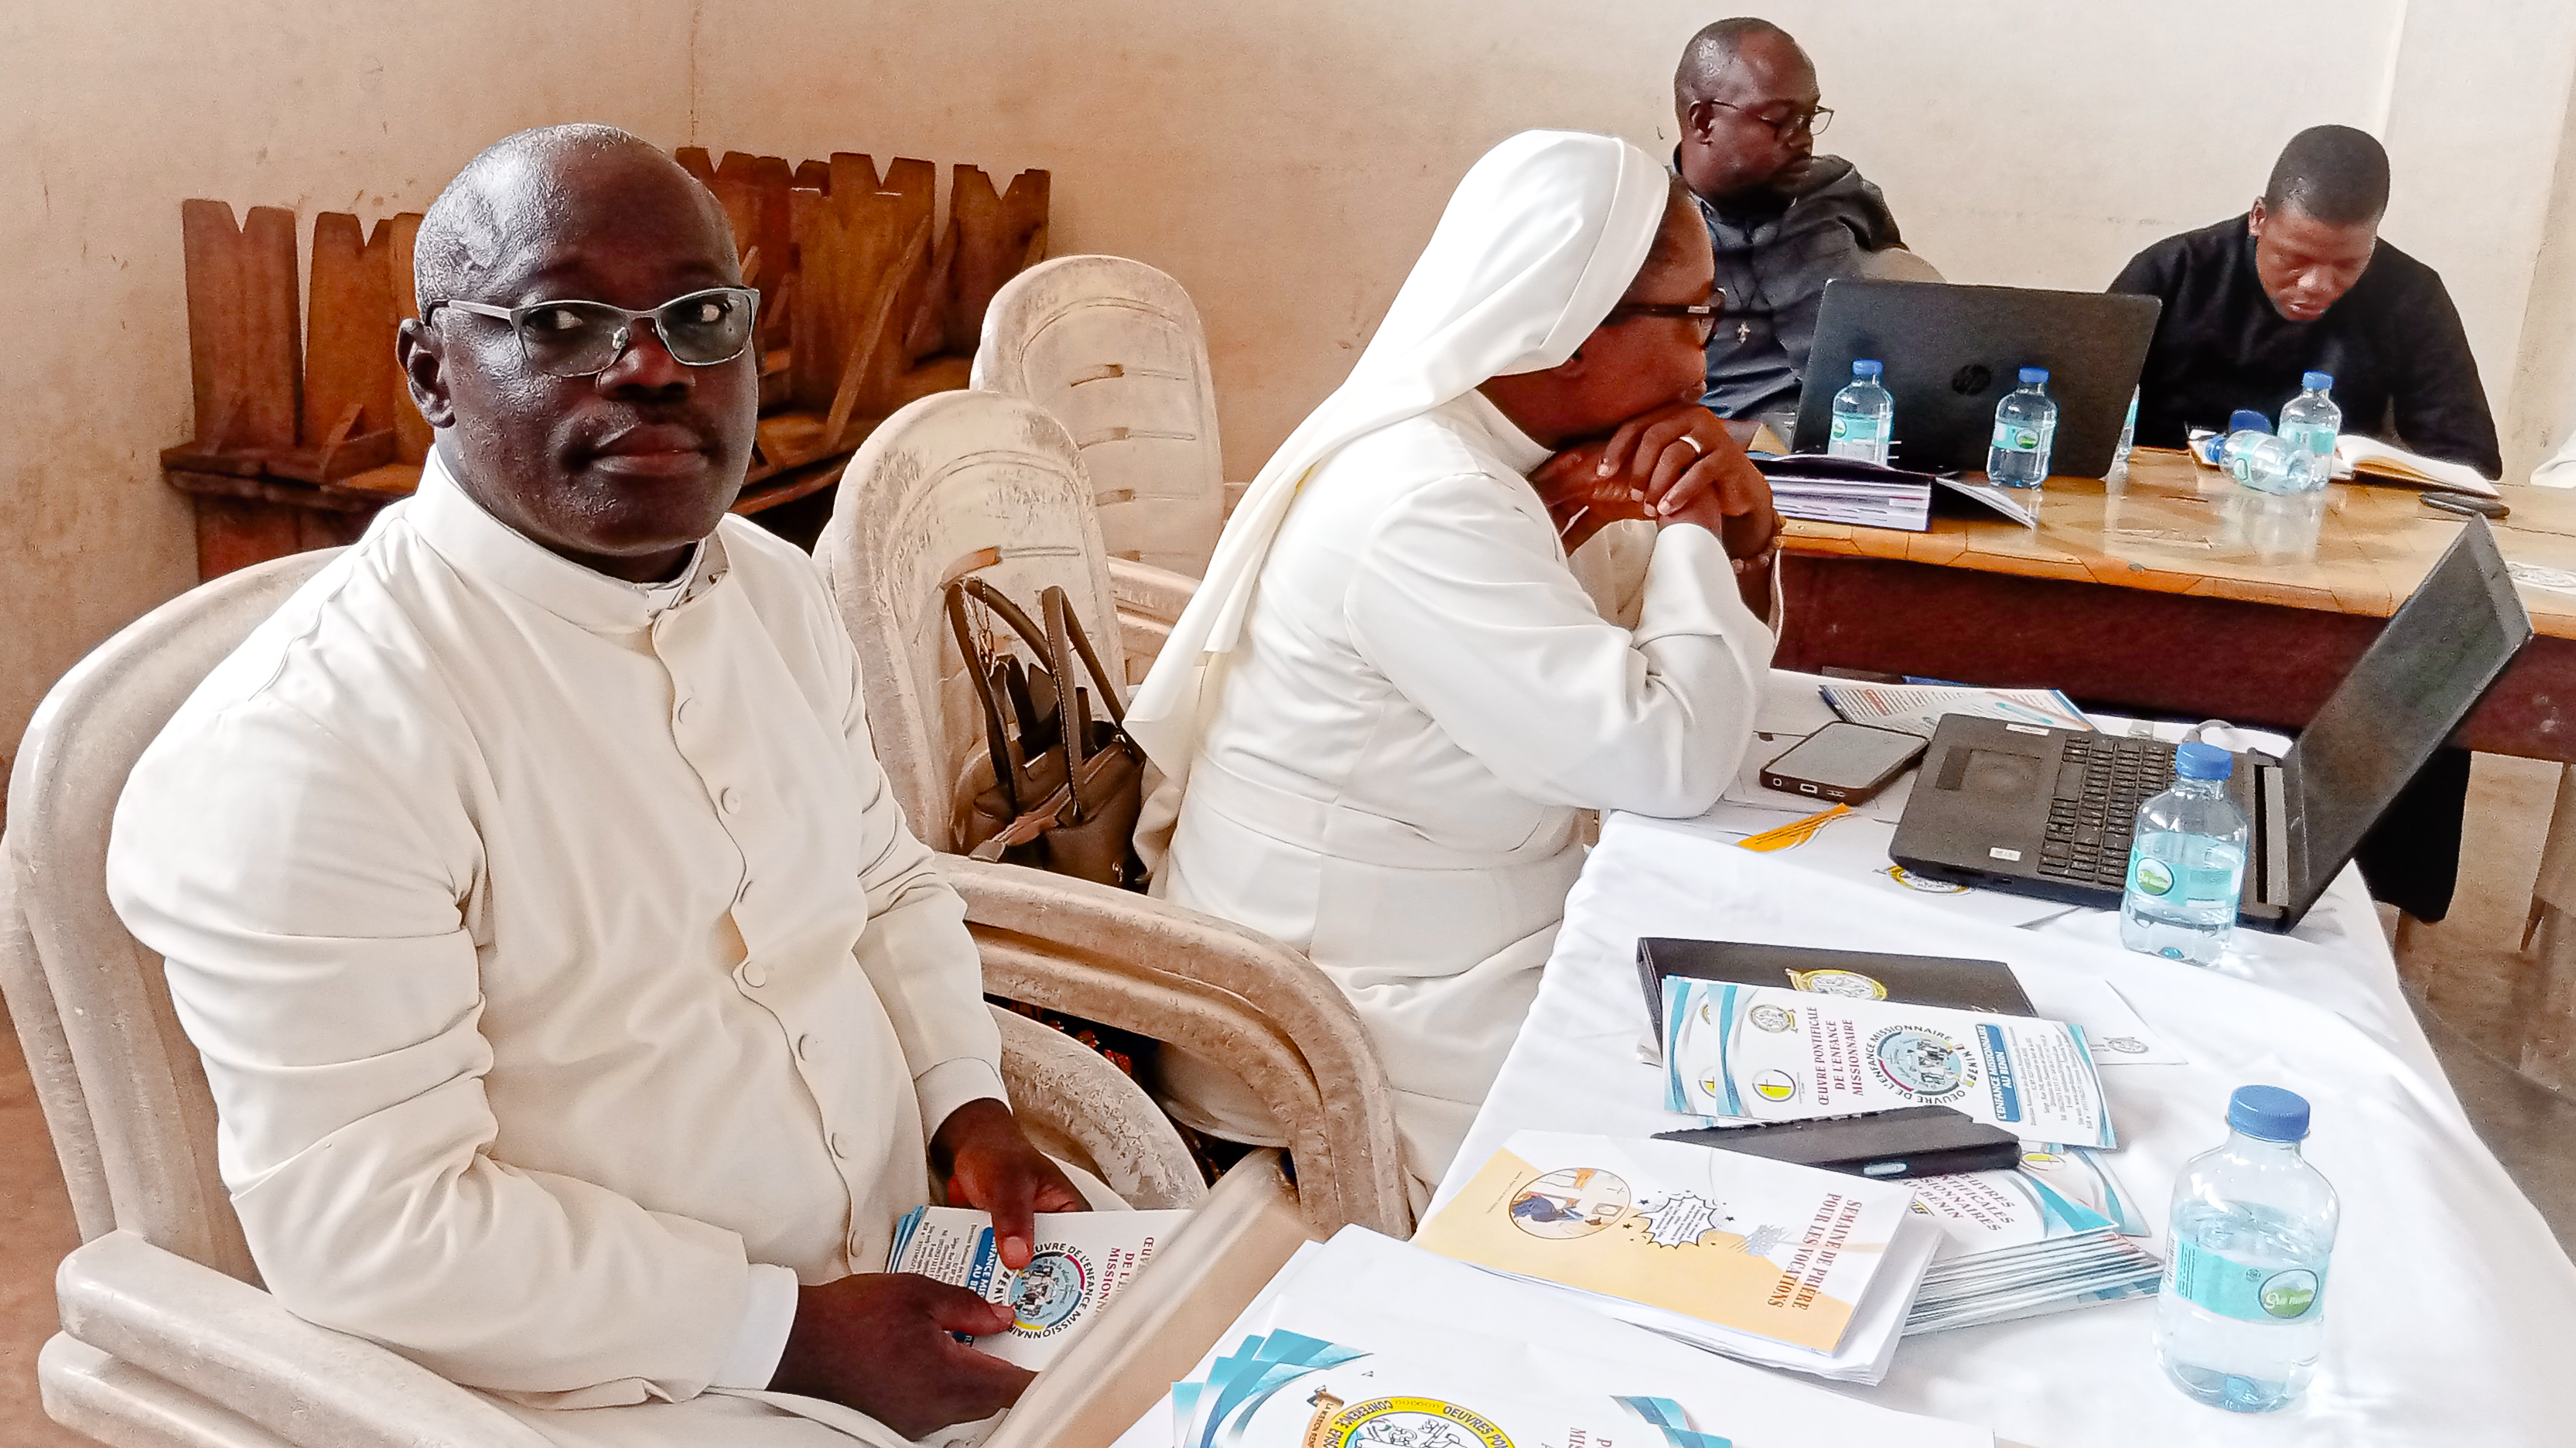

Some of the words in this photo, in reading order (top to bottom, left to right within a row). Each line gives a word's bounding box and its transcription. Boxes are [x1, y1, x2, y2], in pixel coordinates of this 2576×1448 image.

[1806, 1006, 1825, 1064] PONTIFICALE
[1826, 1020, 1844, 1072] L'ENFANCE
[1870, 1025, 1953, 1043] MISSIONNAIRE
[1842, 1019, 1864, 1096] MISSIONNAIRE
[1961, 1050, 1979, 1081] BENIN
[1977, 1025, 2000, 1076] MISSIONNAIRE
[1995, 1050, 2011, 1074] BENIN
[1865, 1043, 1894, 1090] L'ENFANCE
[2000, 1075, 2012, 1088] AU
[1816, 1067, 1830, 1105] ŒUVRE
[1833, 1075, 1846, 1091] DE
[1895, 1088, 1913, 1100] DE
[1917, 1089, 1966, 1105] OEUVRE
[1990, 1076, 2007, 1120] L'ENFANCE
[1813, 1192, 1843, 1224] POUR
[1919, 1178, 2003, 1231] SIONNAIRES
[1942, 1174, 2015, 1224] TIFICALES
[1802, 1224, 1826, 1246] LES
[1826, 1199, 1863, 1249] SEMAINE
[1035, 1242, 1067, 1253] UVRE
[1068, 1245, 1083, 1258] DE
[1122, 1252, 1136, 1269] DE
[1816, 1250, 1837, 1267] DE
[972, 1264, 983, 1279] AU
[1079, 1255, 1095, 1310] L'ENFANCE
[1095, 1247, 1122, 1314] MISSIONN
[1767, 1248, 1815, 1308] VOCATIONS
[1009, 1310, 1082, 1340] MISSIONNAIR
[1334, 1399, 1392, 1429] CONFERENCE
[1443, 1405, 1495, 1435] OEUVRES
